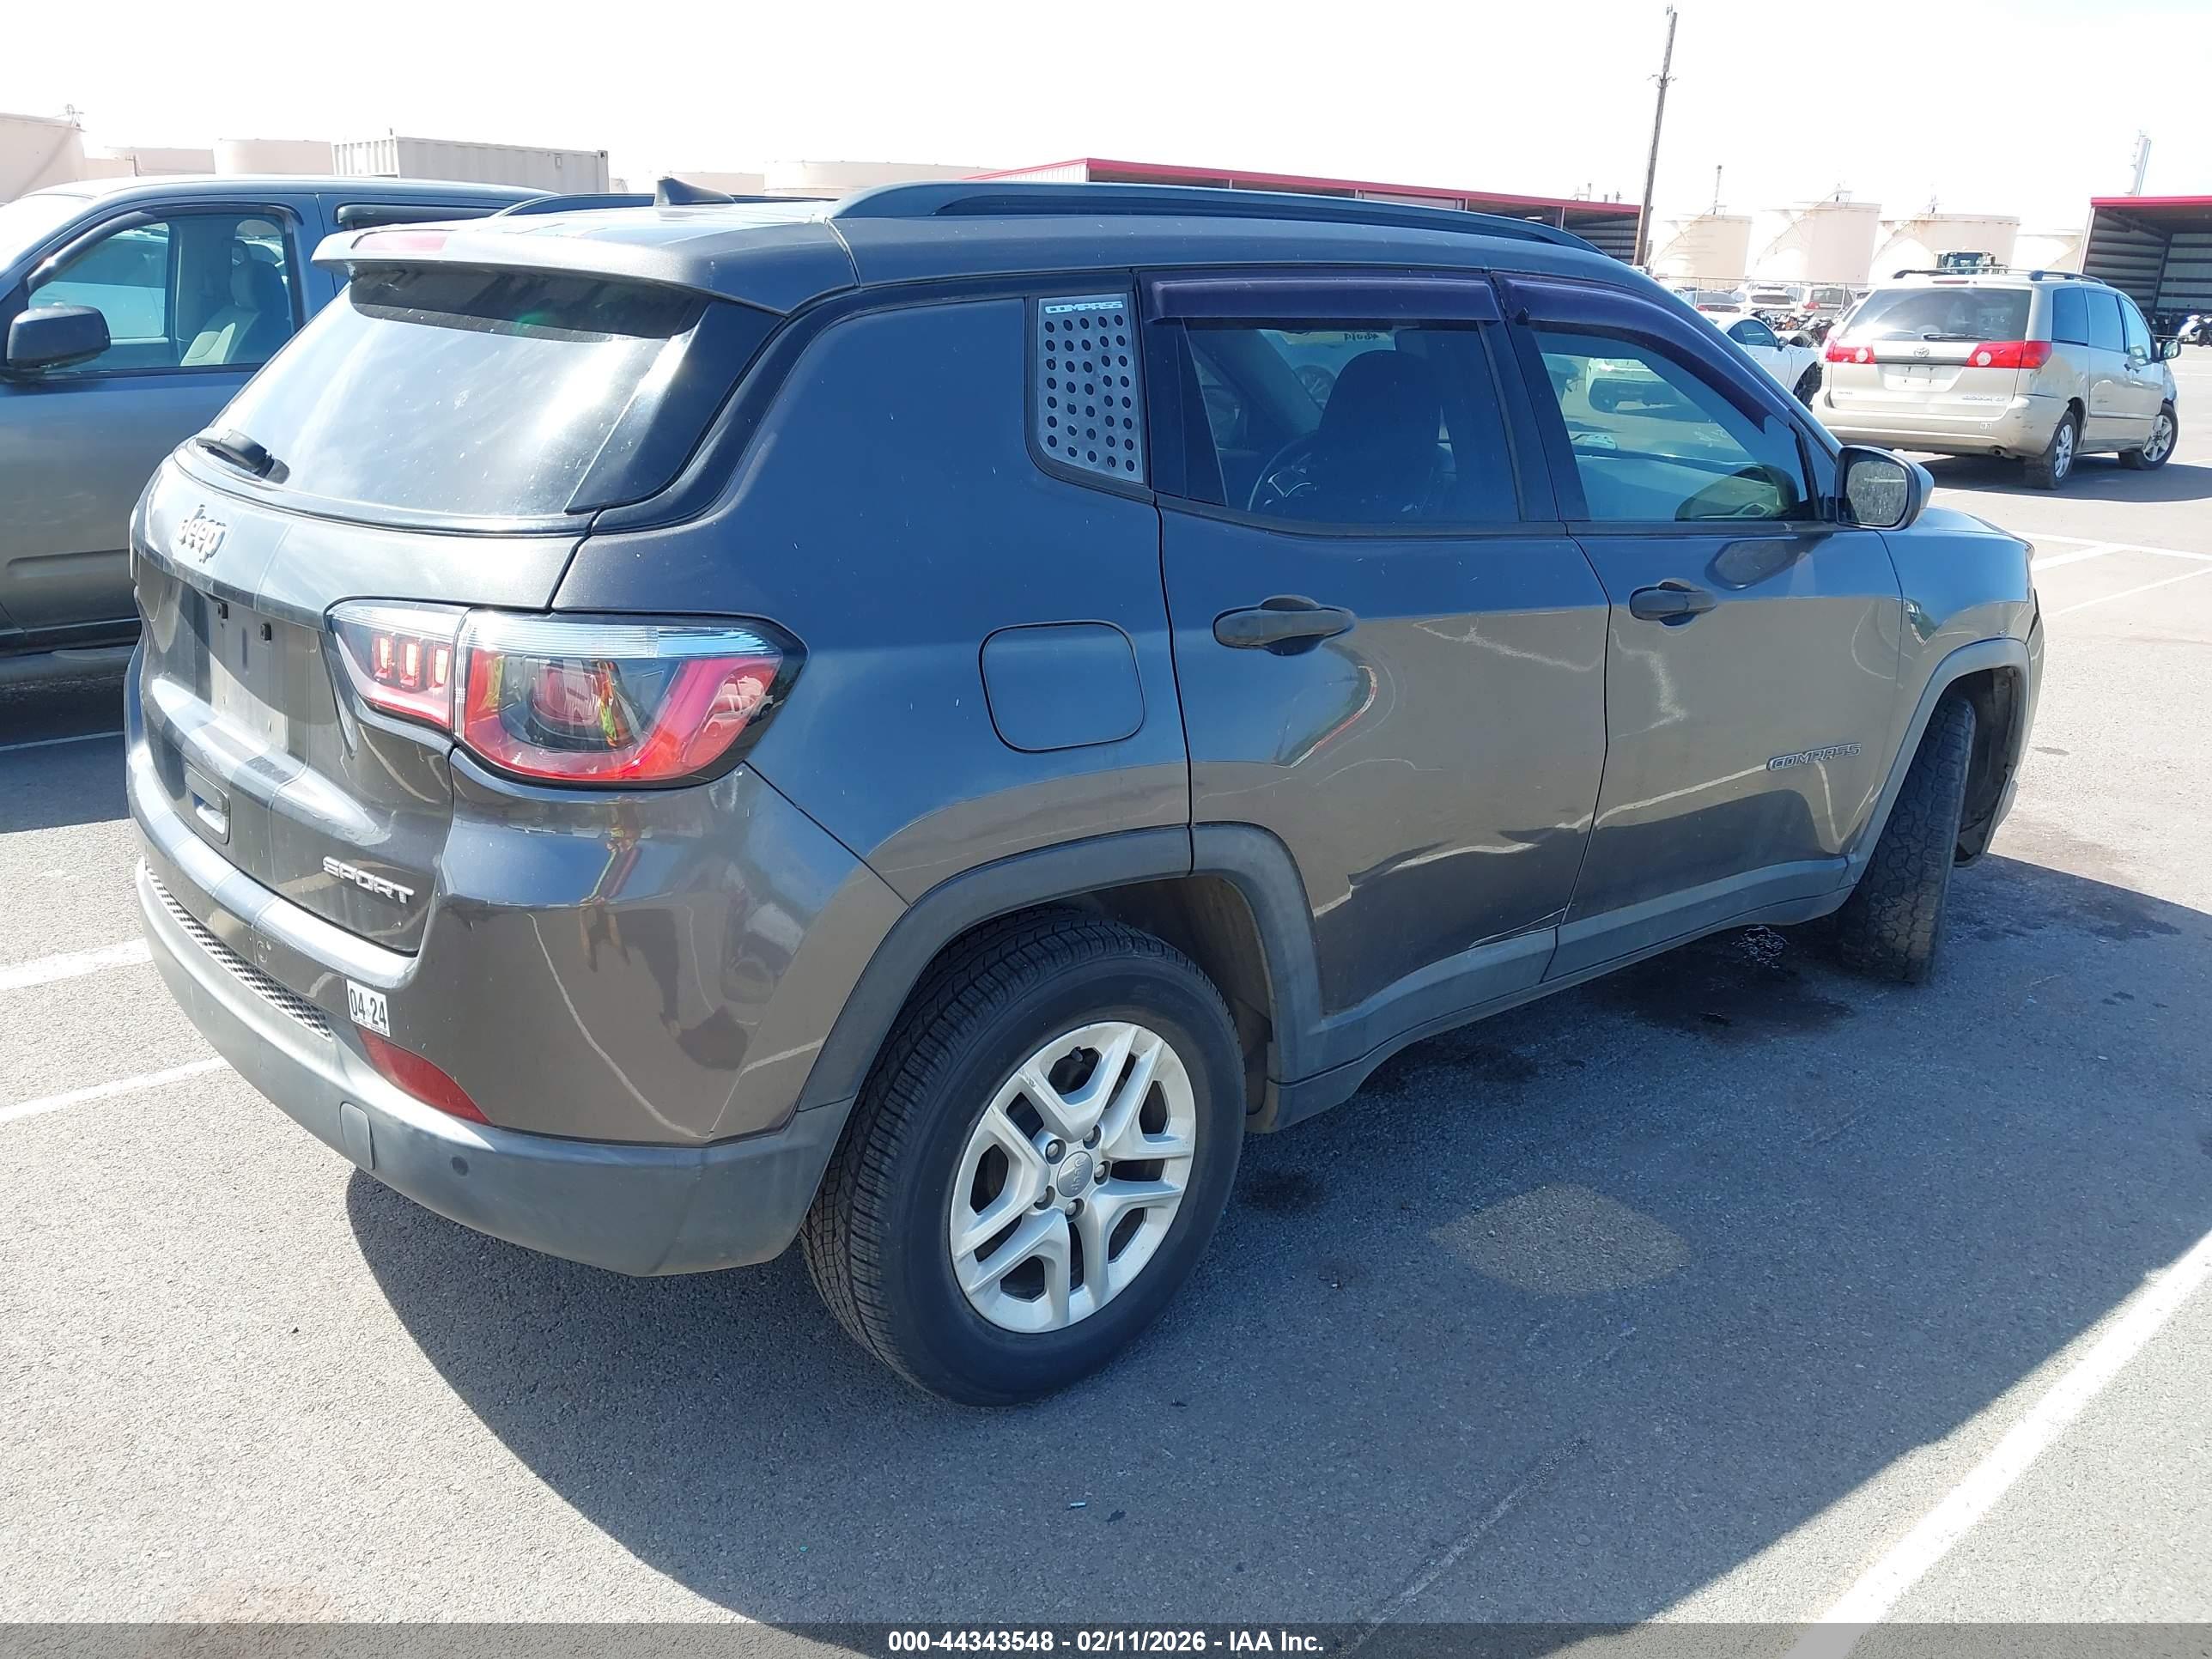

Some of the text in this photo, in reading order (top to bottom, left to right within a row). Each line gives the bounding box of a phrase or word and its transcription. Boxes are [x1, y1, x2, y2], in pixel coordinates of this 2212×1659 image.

[1045, 301, 1123, 314] COMPASS
[175, 504, 227, 564] Jeep
[1766, 742, 1862, 771] COMPASS
[322, 856, 415, 904] SPORT
[1071, 1156, 1087, 1191] Jeep
